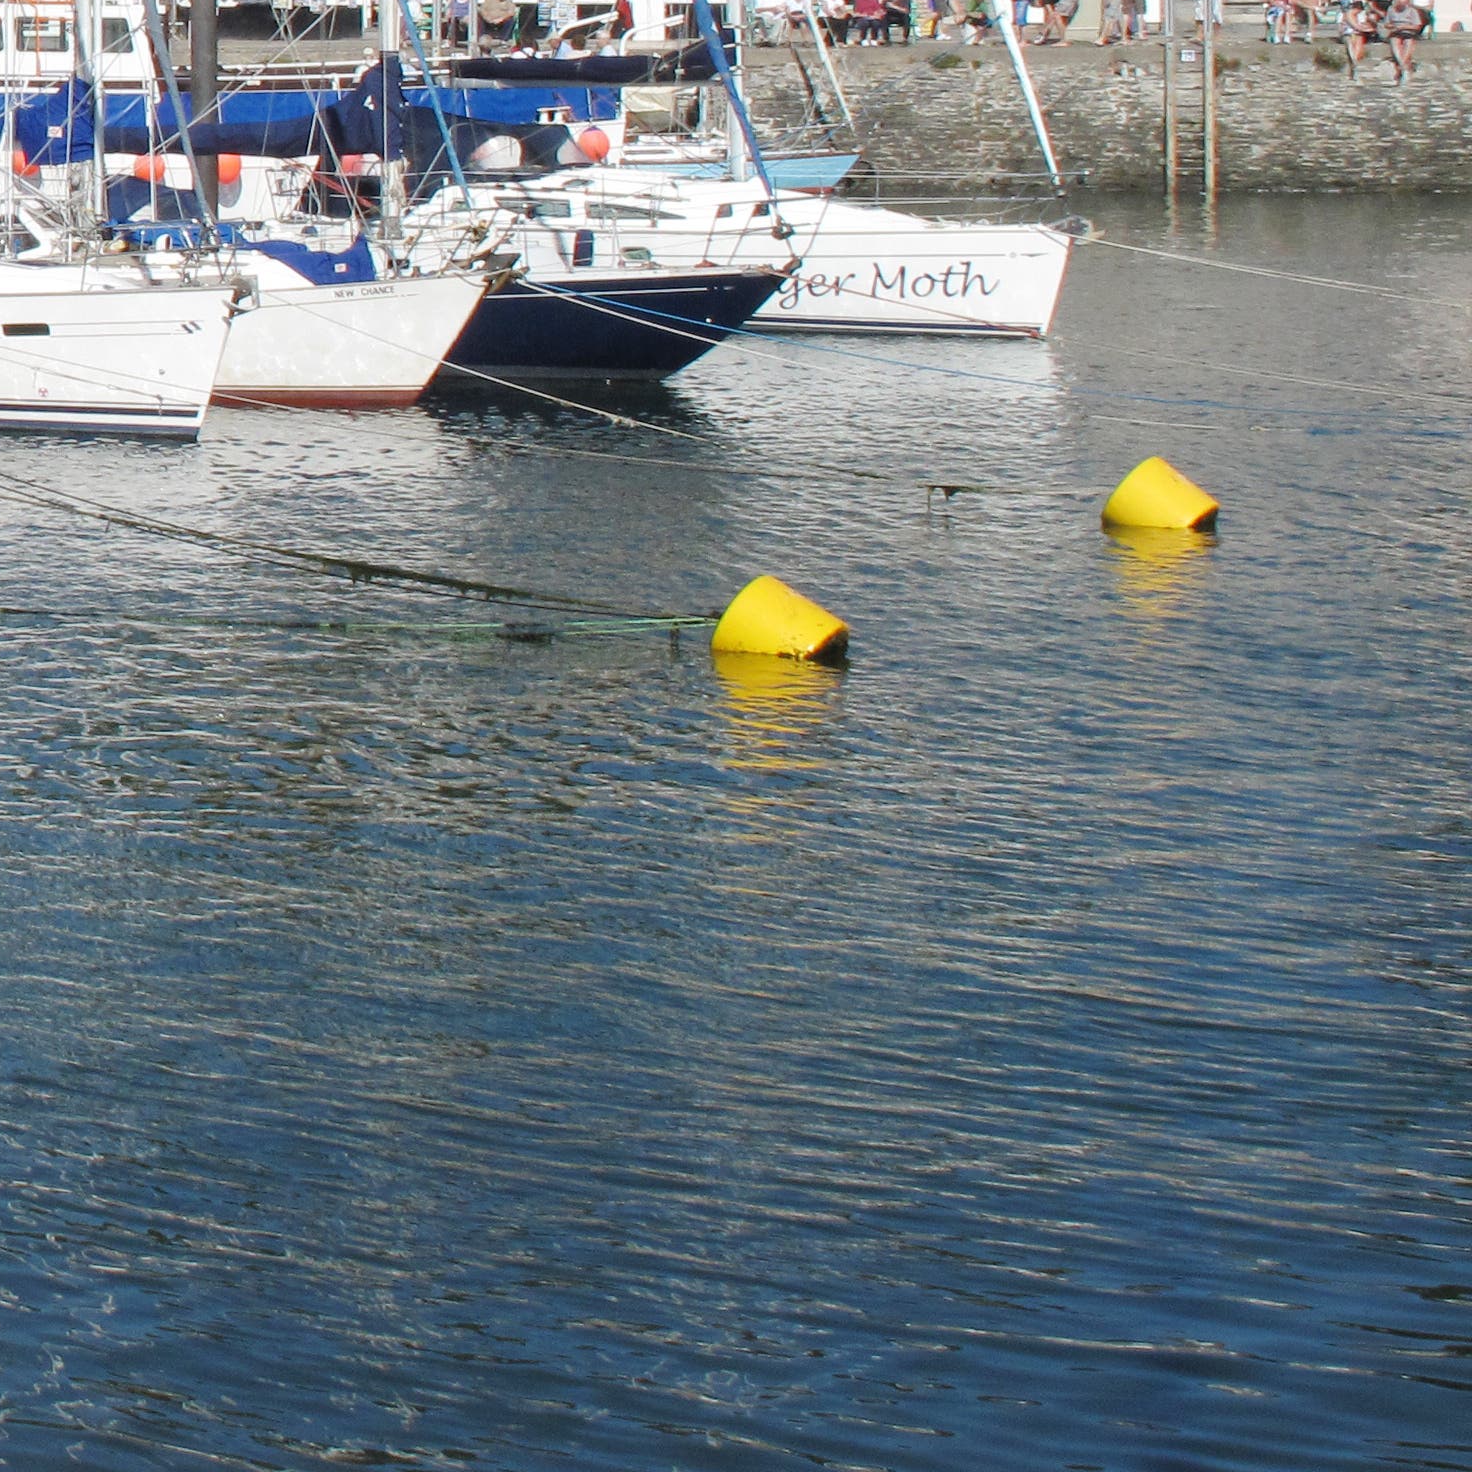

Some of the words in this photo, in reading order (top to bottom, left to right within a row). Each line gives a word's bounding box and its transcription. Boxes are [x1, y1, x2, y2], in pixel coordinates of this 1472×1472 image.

[334, 290, 354, 298] NEW
[361, 285, 394, 296] CHANCE
[871, 261, 1000, 299] Moth
